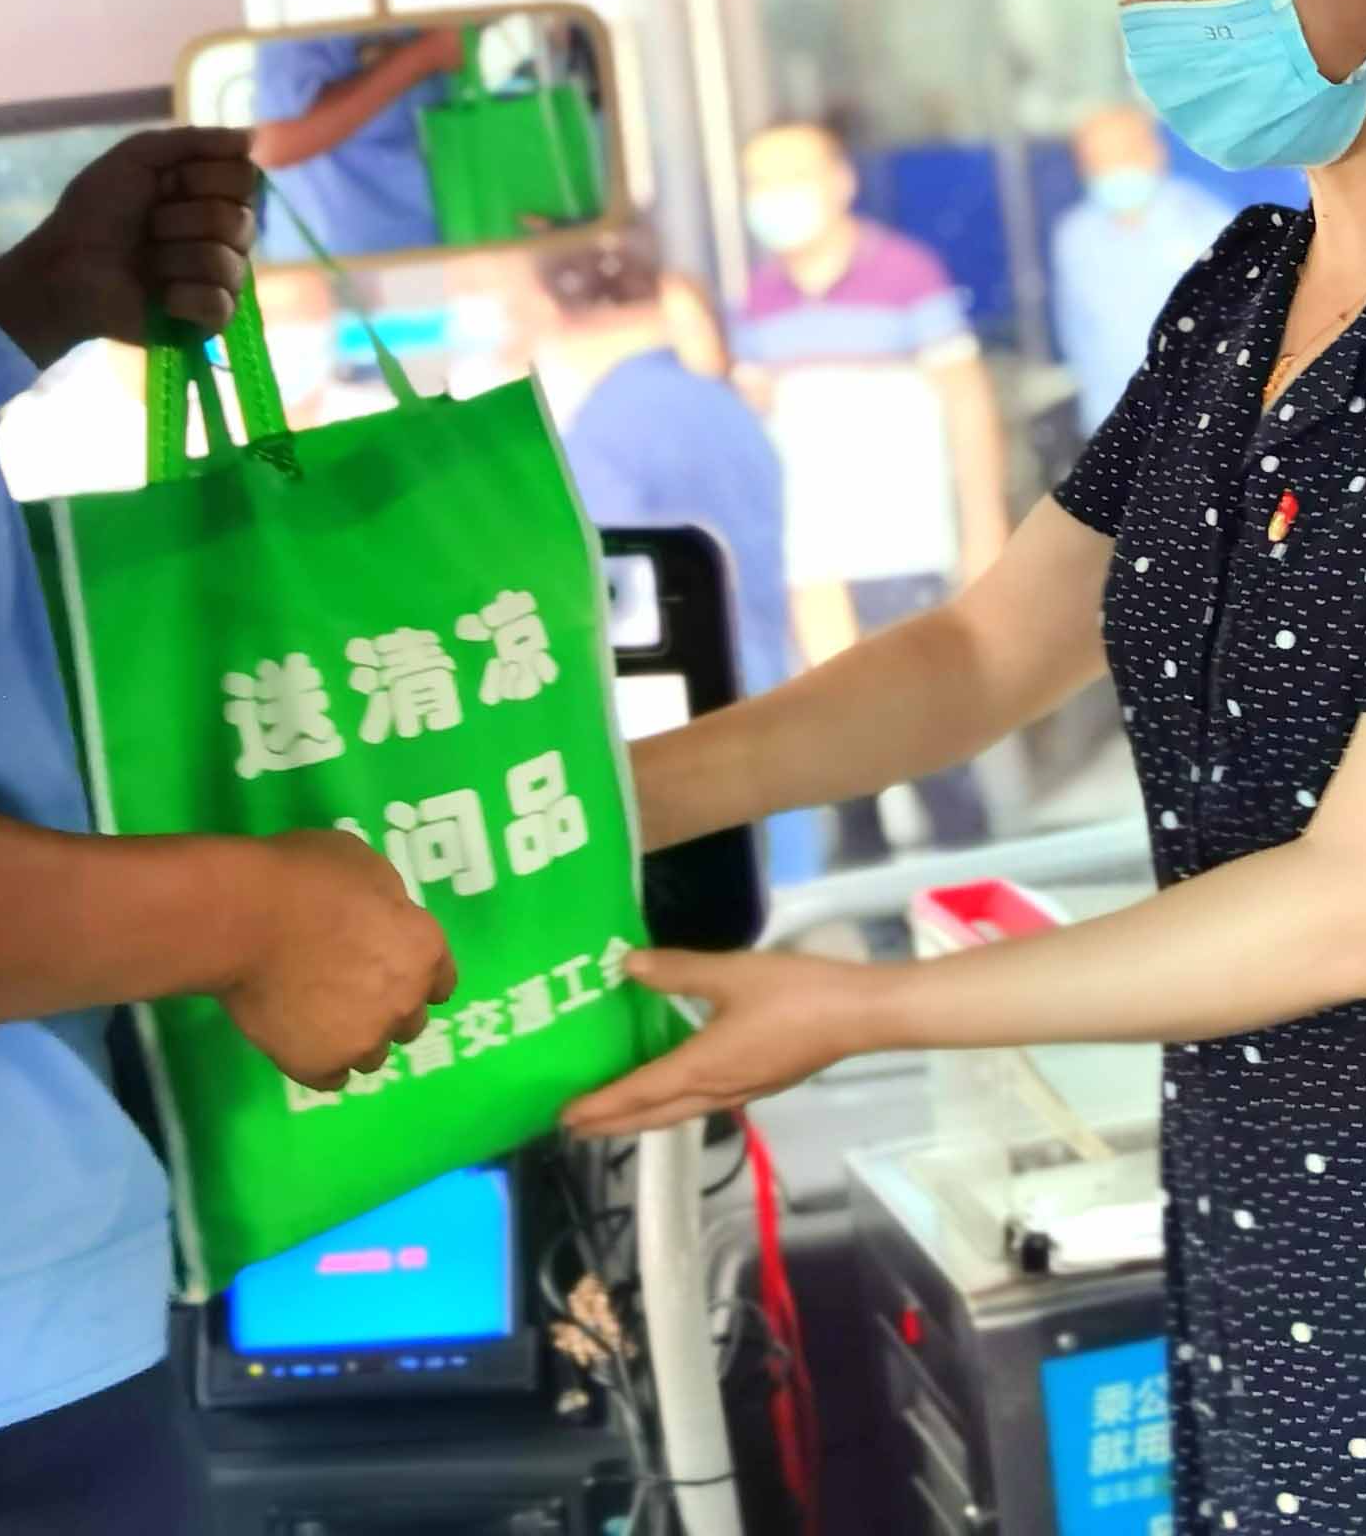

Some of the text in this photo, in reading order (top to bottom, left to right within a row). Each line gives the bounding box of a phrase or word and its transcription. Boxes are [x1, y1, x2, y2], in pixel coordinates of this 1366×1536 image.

[221, 589, 559, 780] 送清凉
[335, 750, 589, 908] 问品
